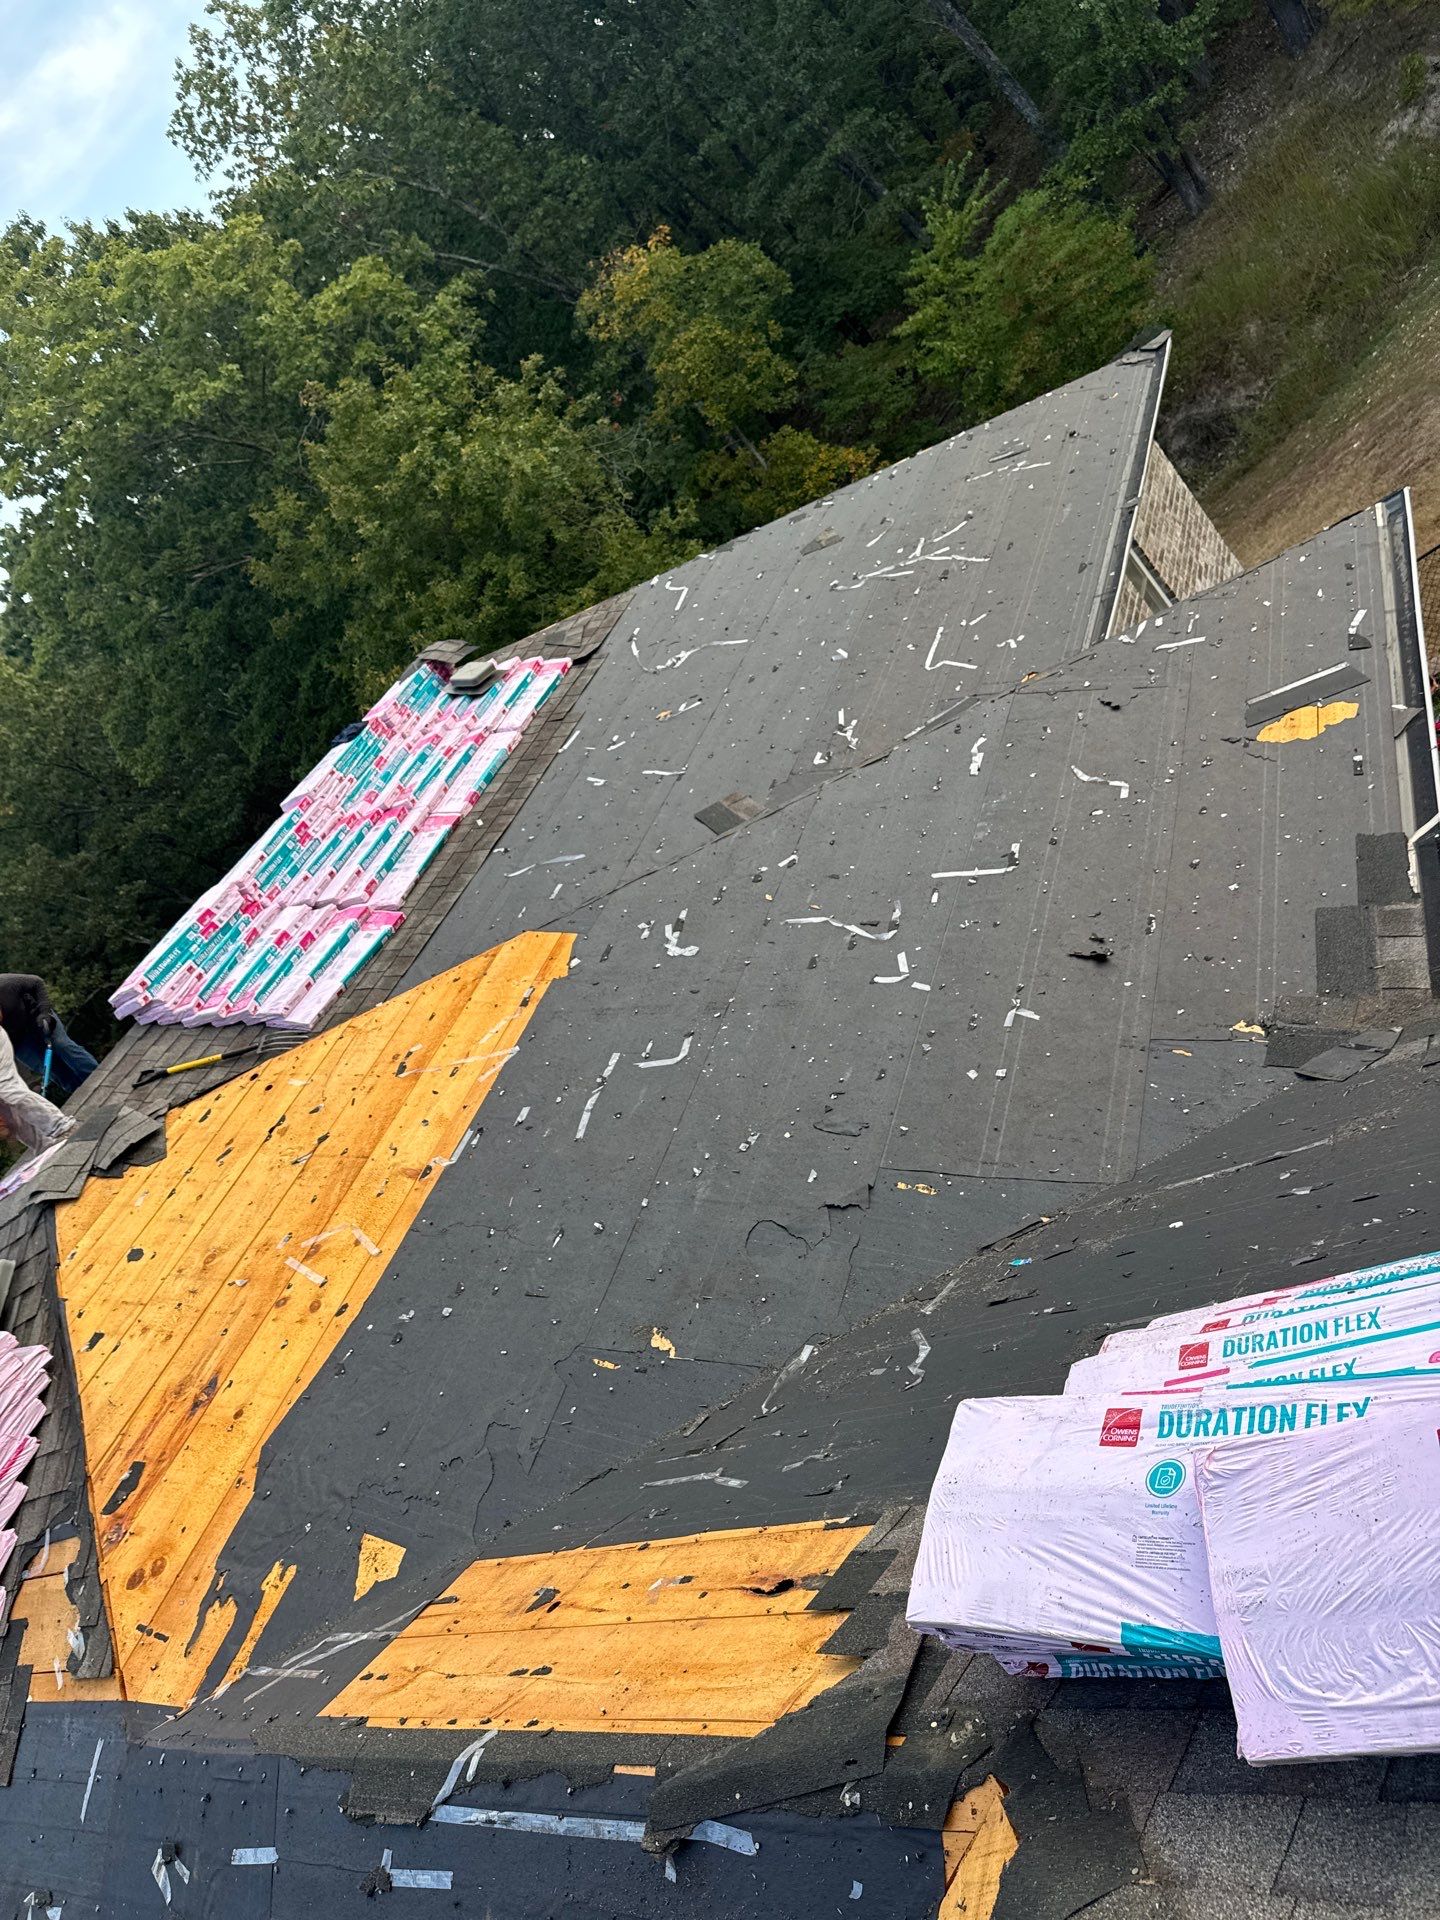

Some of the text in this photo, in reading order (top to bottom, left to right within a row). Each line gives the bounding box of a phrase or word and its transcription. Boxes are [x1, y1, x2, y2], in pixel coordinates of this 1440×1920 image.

[1223, 1320, 1328, 1358] DURATION
[1334, 1306, 1381, 1337] FLEX
[1157, 1404, 1296, 1439] DURATION
[1102, 1434, 1137, 1442] CORNING
[1110, 1427, 1138, 1435] OWENS
[1069, 1662, 1189, 1679] DURATION
